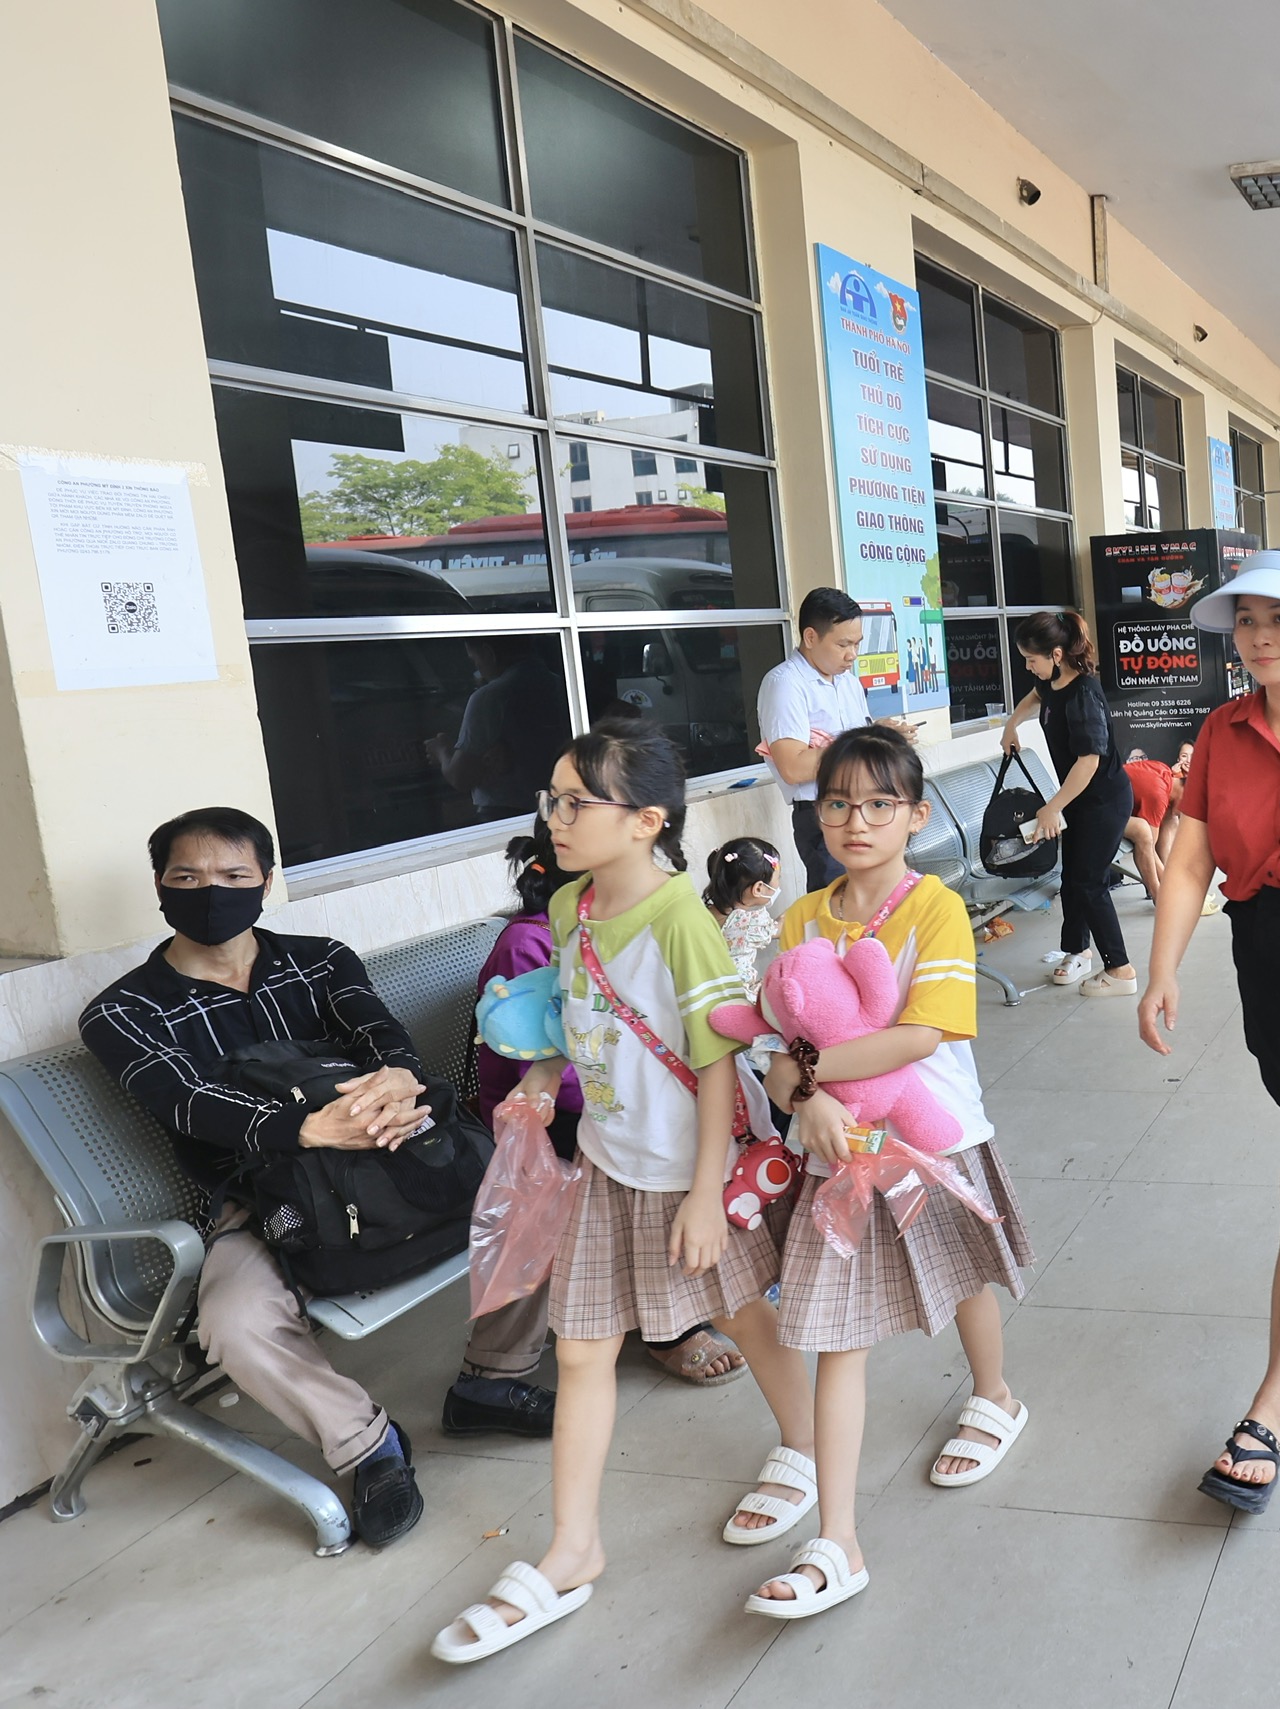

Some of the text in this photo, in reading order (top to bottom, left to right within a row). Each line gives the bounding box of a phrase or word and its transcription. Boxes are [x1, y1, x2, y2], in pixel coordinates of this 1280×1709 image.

[852, 350, 904, 382] TUỔI TRẺ
[860, 384, 902, 411] THỦ ĐÔ
[856, 413, 910, 444] TÍCH CỰC
[860, 444, 912, 473] SỬ DỤNG
[848, 478, 926, 506] PHƯƠNG TIỆN
[856, 510, 924, 534] GIAO THÔNG
[860, 540, 926, 565] CÔNG CỘNG
[1160, 542, 1196, 554] VMAC
[1118, 625, 1127, 634] HỆ
[1128, 624, 1150, 633] THỐNG
[1152, 624, 1166, 632] MÁY
[1119, 632, 1196, 654] ĐỒ UỐNG
[1120, 652, 1198, 674] TỰ ĐỘNG
[1121, 676, 1138, 686] LỚN
[1138, 674, 1160, 685] NHẤT
[1160, 674, 1178, 686] VIỆT
[1110, 710, 1123, 718] Liên
[1124, 710, 1132, 718] hệ
